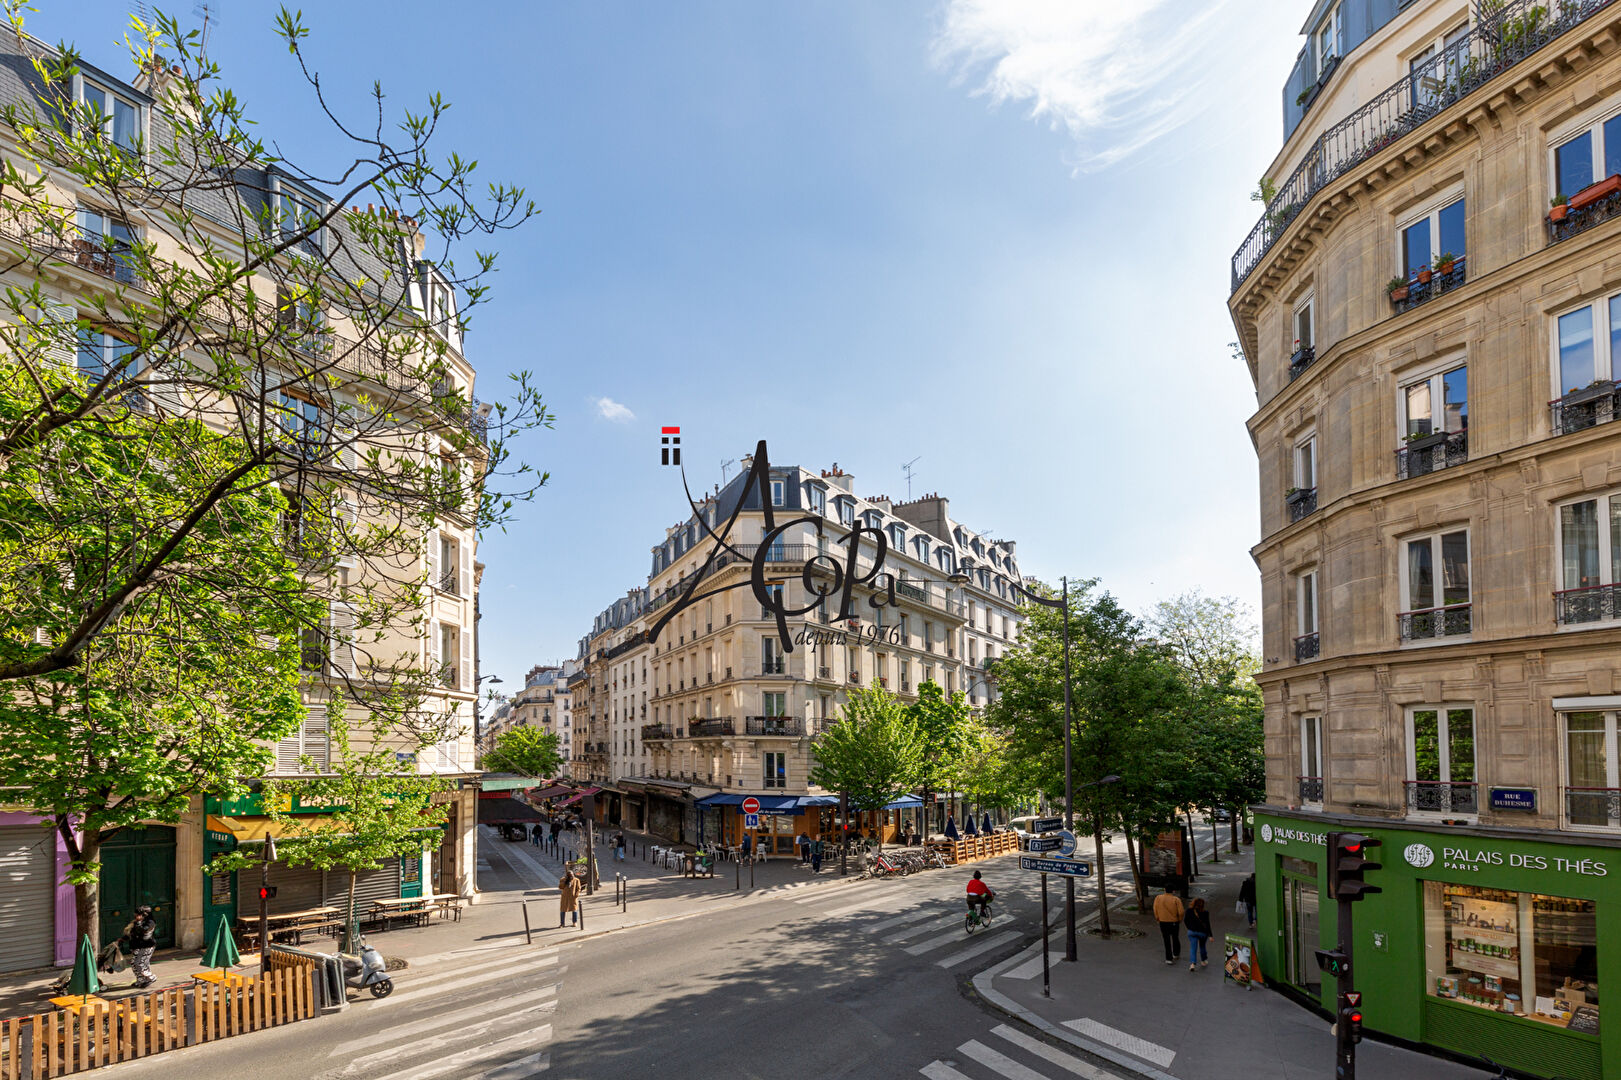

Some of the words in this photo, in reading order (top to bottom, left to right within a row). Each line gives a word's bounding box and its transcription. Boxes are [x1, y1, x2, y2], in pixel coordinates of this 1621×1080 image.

[1494, 799, 1533, 808] DUHESME
[1274, 826, 1296, 840] PALAIS
[1296, 830, 1310, 843] DES
[1443, 847, 1504, 866] PALAIS
[1509, 853, 1548, 870] DES
[1552, 857, 1608, 877] THÉS
[1444, 862, 1480, 872] PARIS
